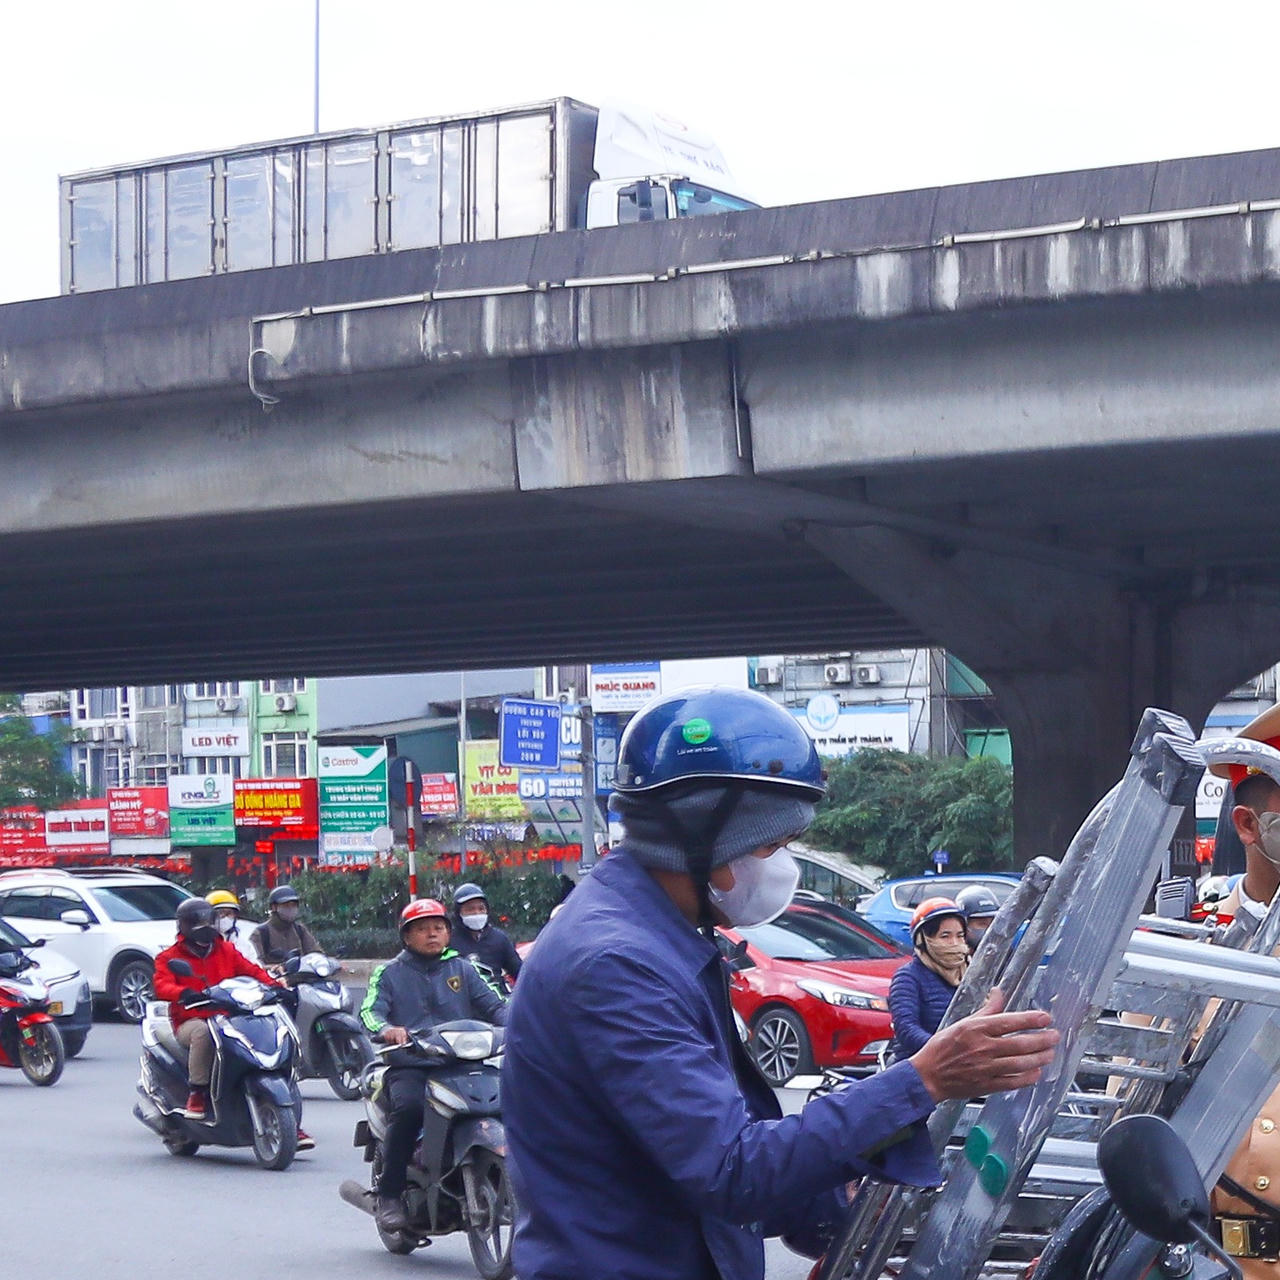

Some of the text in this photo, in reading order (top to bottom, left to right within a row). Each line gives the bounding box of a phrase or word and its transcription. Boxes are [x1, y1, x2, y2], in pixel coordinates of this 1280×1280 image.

[191, 736, 212, 747] LED
[331, 756, 359, 767] Castrol
[520, 778, 546, 798] 60
